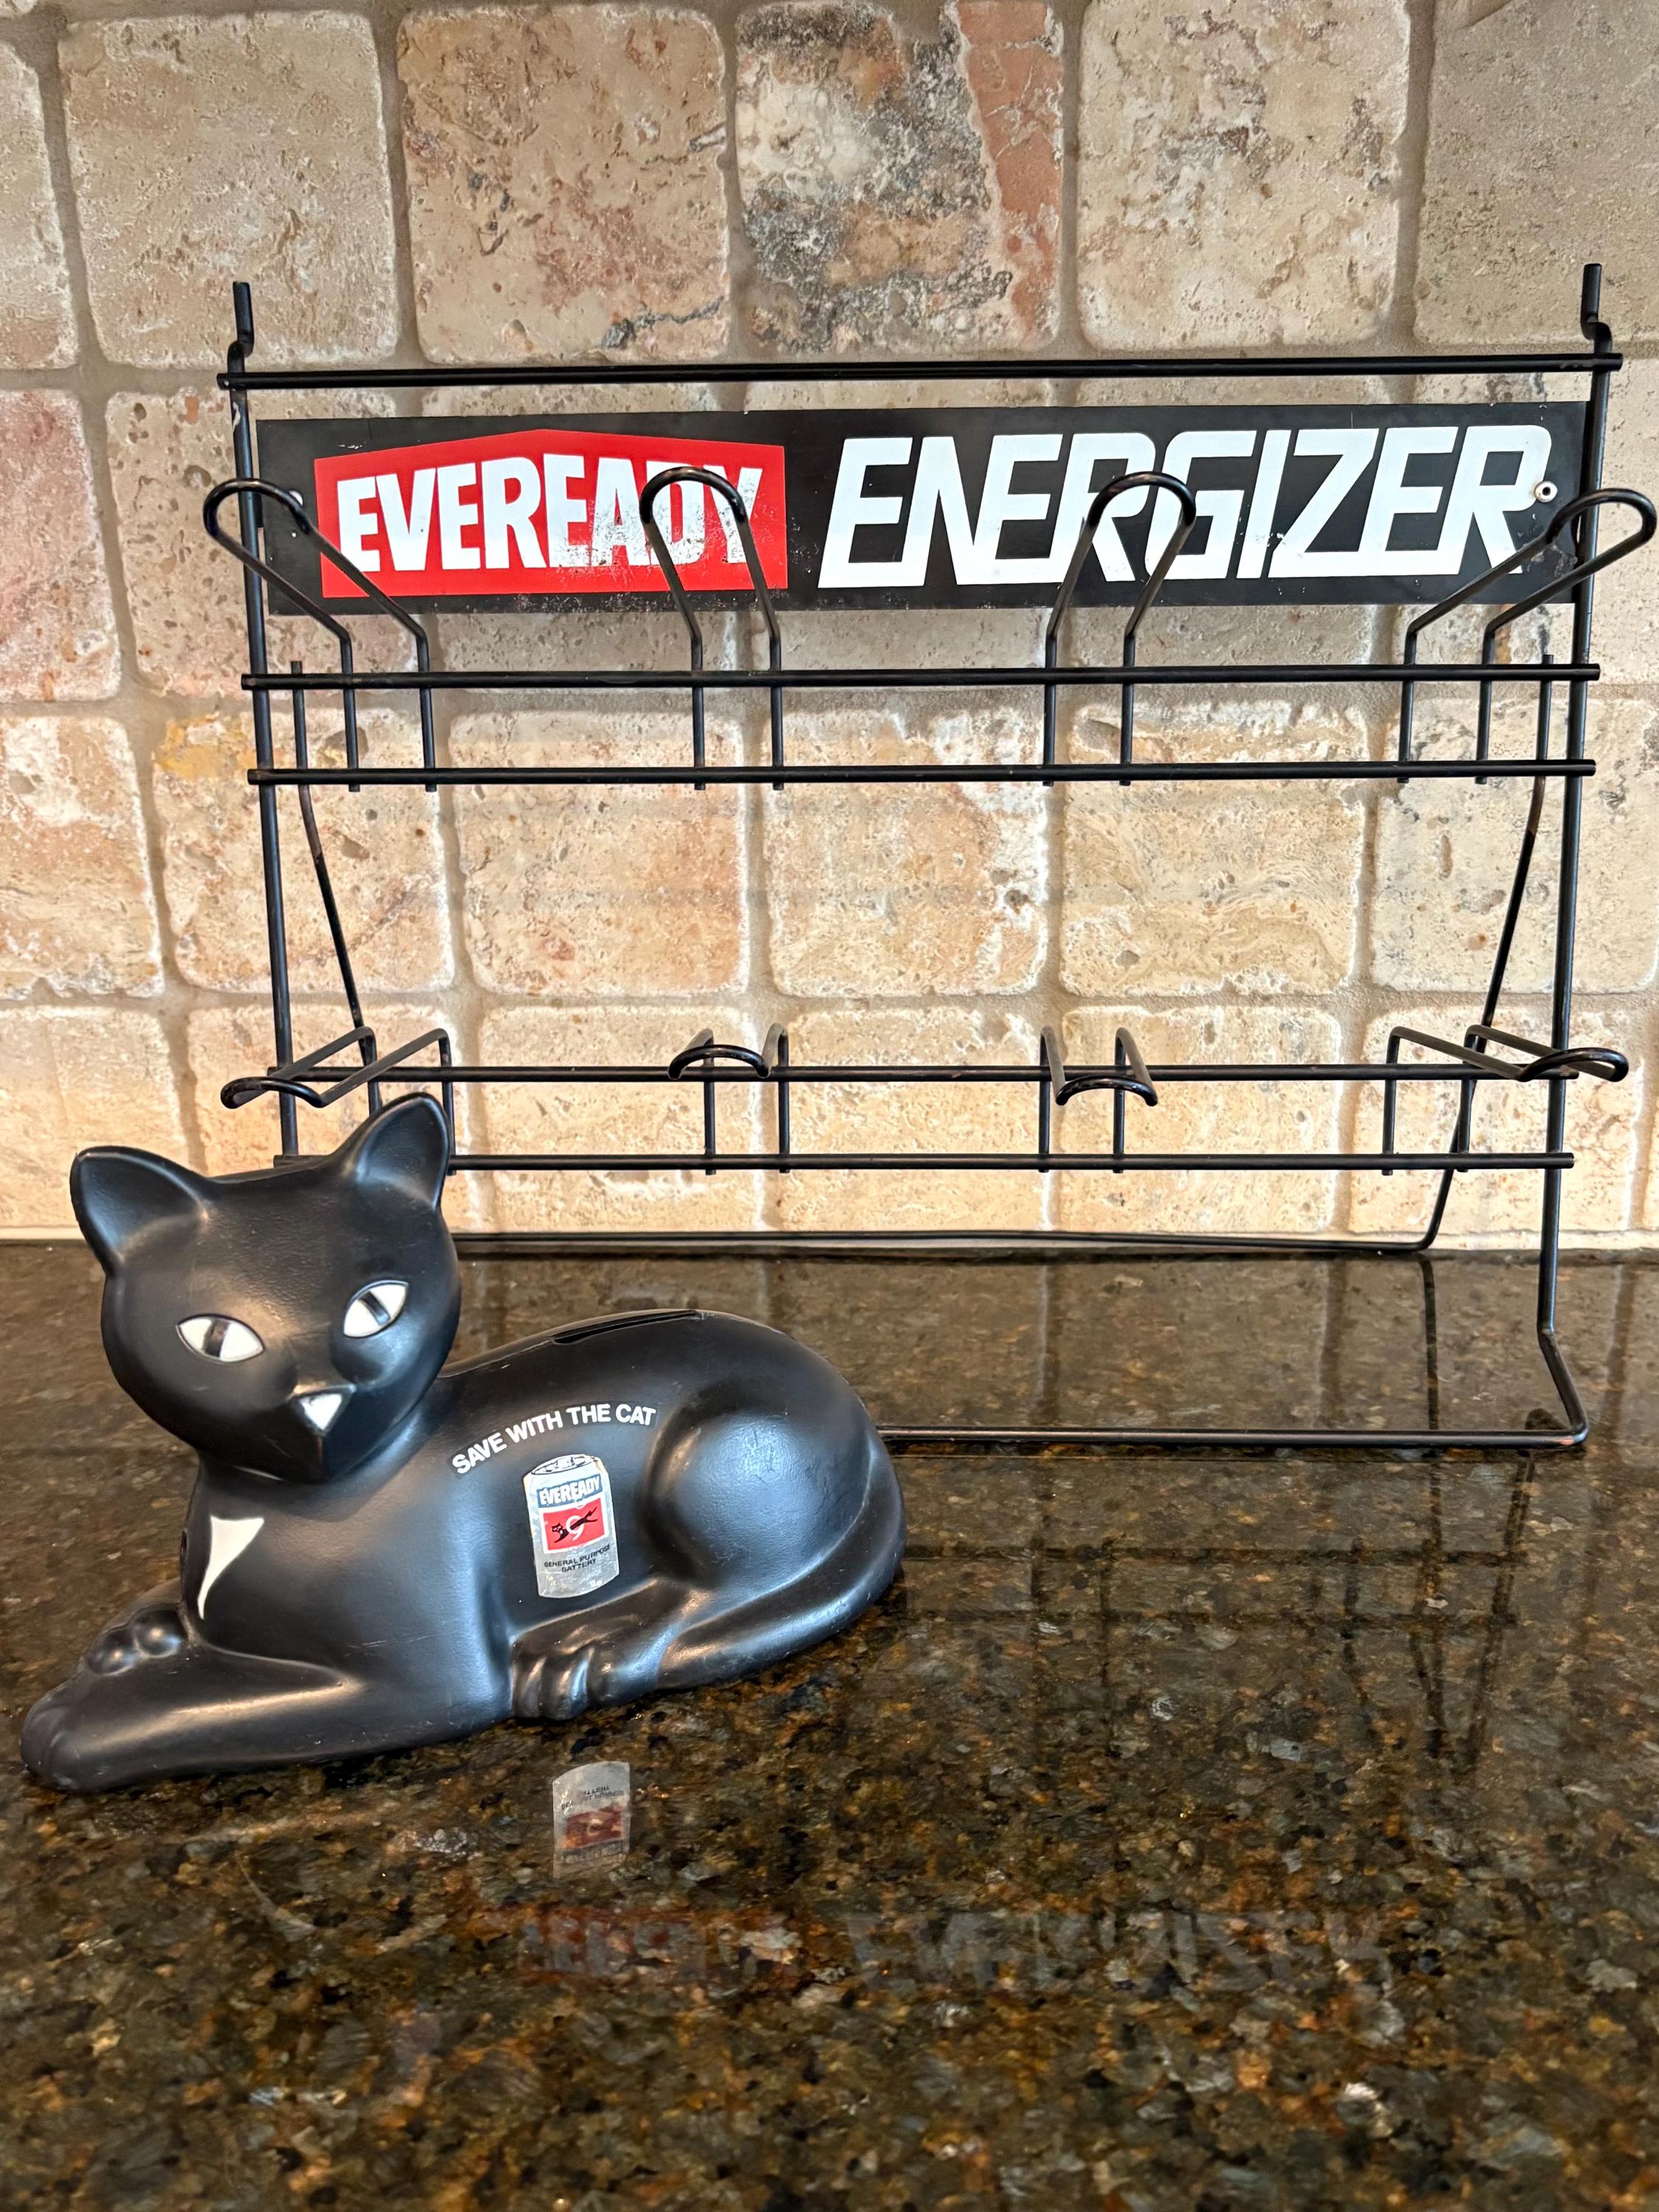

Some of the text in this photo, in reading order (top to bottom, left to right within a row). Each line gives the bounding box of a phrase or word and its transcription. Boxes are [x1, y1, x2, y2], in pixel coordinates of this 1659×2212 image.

[337, 425, 1551, 588] EVEREADY ENERGIZER
[452, 1403, 656, 1474] SAVE WITH THE CAT
[540, 1476, 601, 1505] EVEREADY
[566, 1515, 585, 1541] 9
[544, 1543, 611, 1568] GENERAL PURPOSE
[561, 1559, 597, 1572] BATTERY
